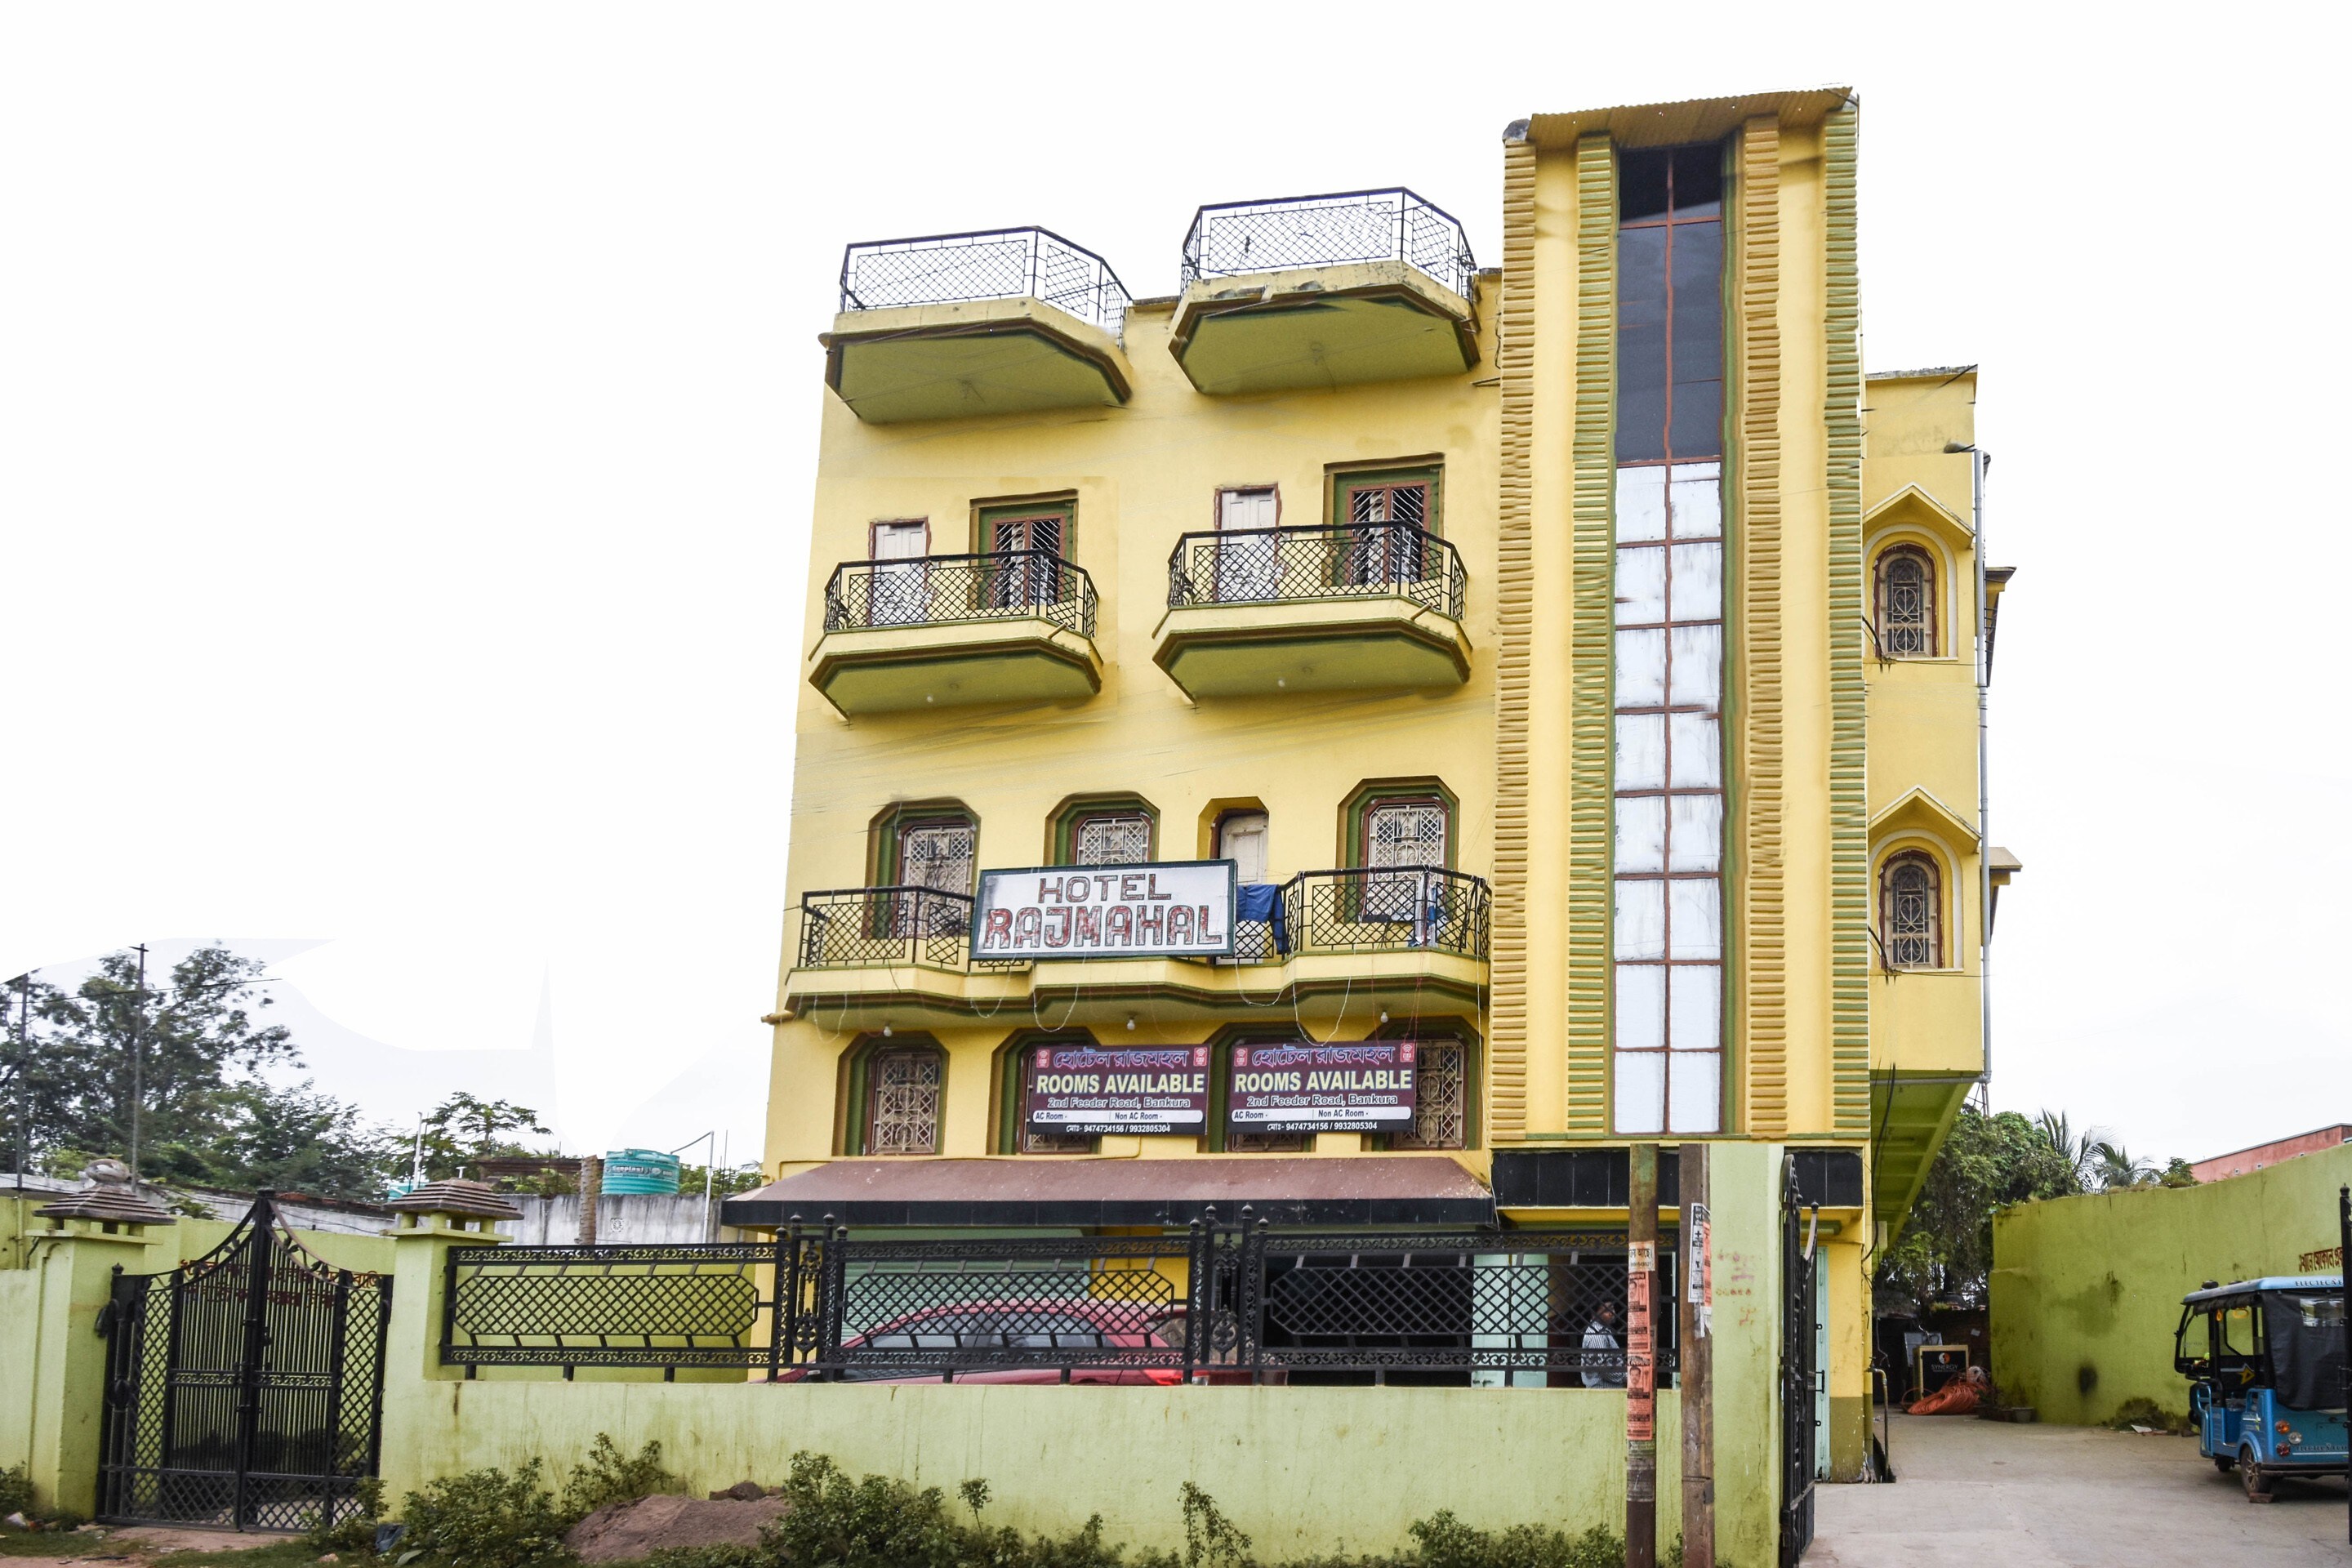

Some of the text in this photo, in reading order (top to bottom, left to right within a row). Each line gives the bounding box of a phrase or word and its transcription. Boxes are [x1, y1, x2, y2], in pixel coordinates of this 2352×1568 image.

[1037, 873, 1172, 903] HOTEL
[982, 905, 1223, 950] RAJMAHAL
[1054, 1046, 1111, 1070] হোটেল
[1113, 1049, 1190, 1069] রাজমহল
[1252, 1044, 1312, 1068] হোটেল
[1315, 1045, 1396, 1065] রাজমহল
[1036, 1073, 1205, 1094] ROOMS AVAILABLE
[1234, 1069, 1413, 1093] ROOMS AVAILABLE
[1047, 1097, 1191, 1110] 2nd Feeder Road, Bankura
[1246, 1094, 1398, 1107] 2nd Feeder Road, Bankura
[1345, 1109, 1365, 1117] Room
[1084, 1125, 1124, 1133] 9474734156
[1129, 1125, 1170, 1133] 9932805304
[1285, 1122, 1329, 1130] 9474734156
[1334, 1121, 1378, 1130] 9932805304
